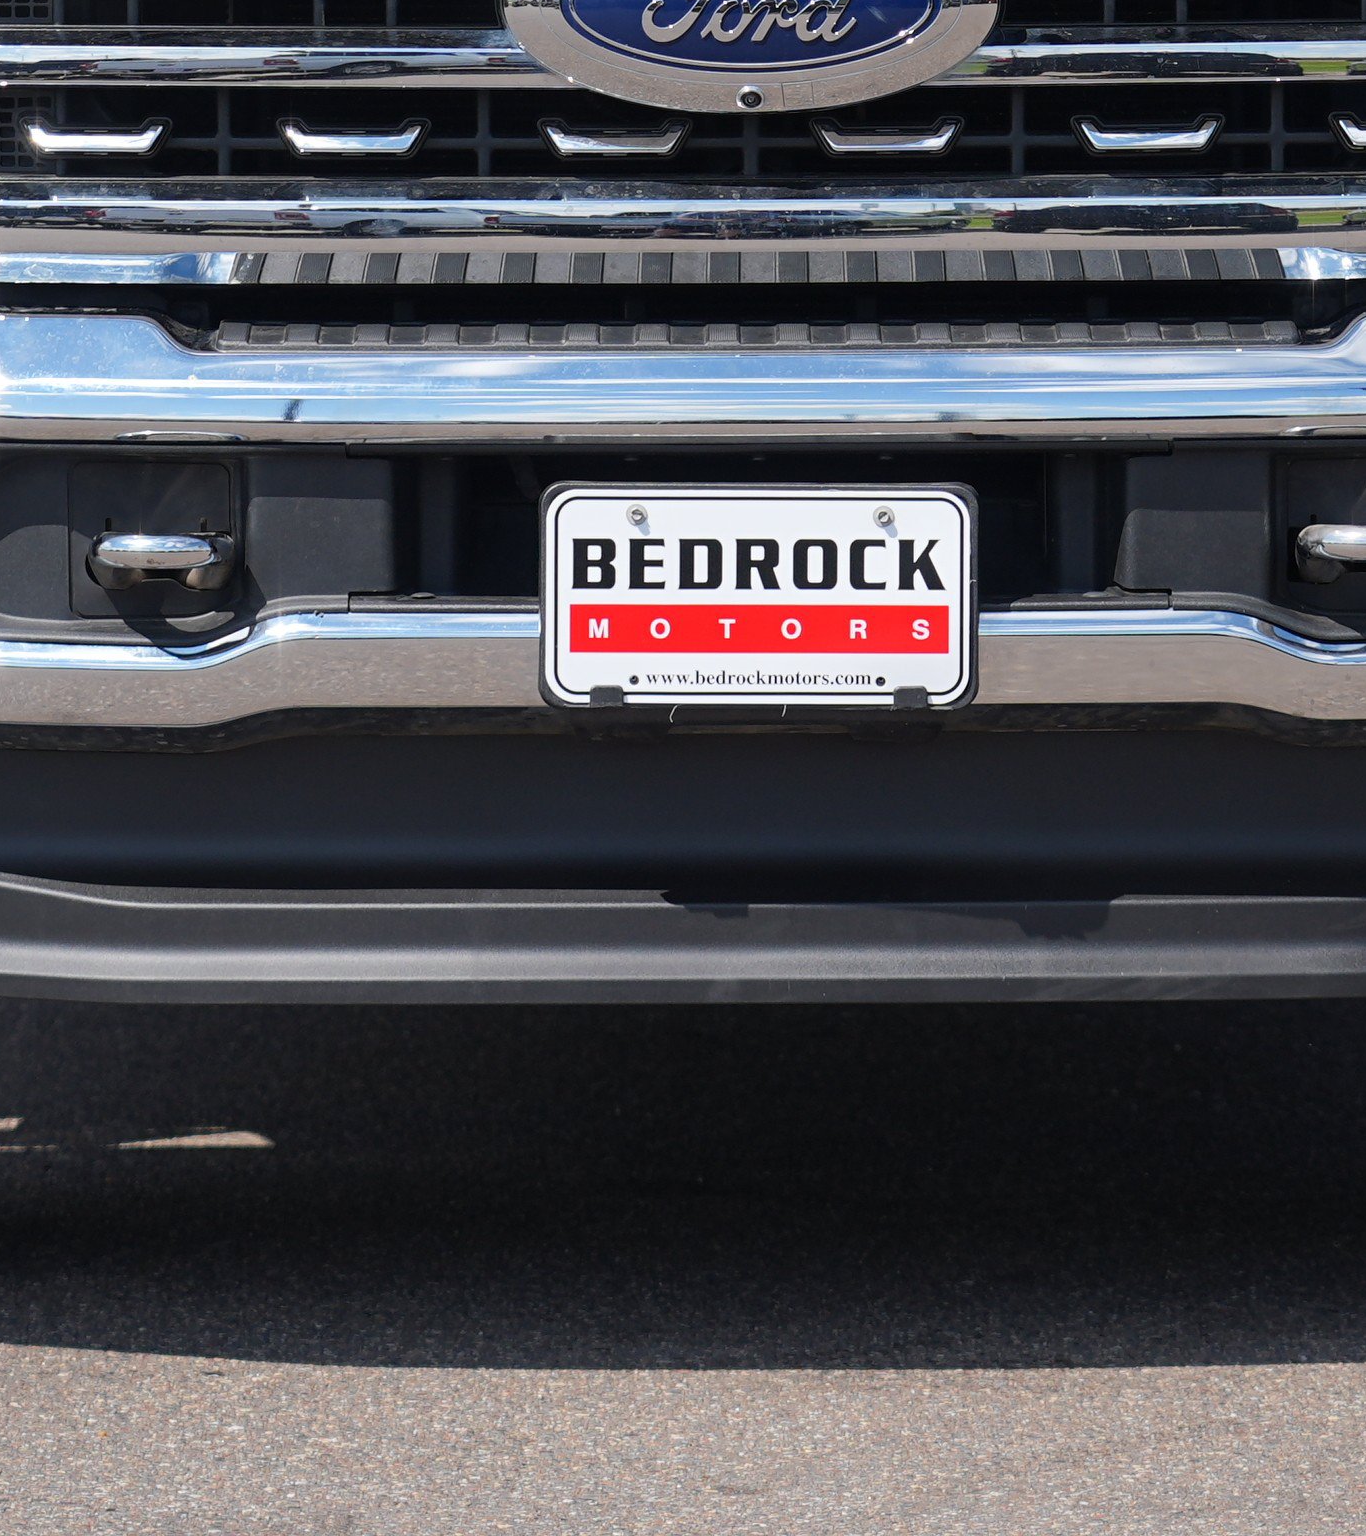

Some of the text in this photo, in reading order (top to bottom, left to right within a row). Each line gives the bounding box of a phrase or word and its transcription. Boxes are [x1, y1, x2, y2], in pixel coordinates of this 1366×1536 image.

[572, 538, 946, 591] BEDROCK
[588, 618, 930, 640] MOTORS
[646, 670, 871, 686] www.bedrockmotors.com
